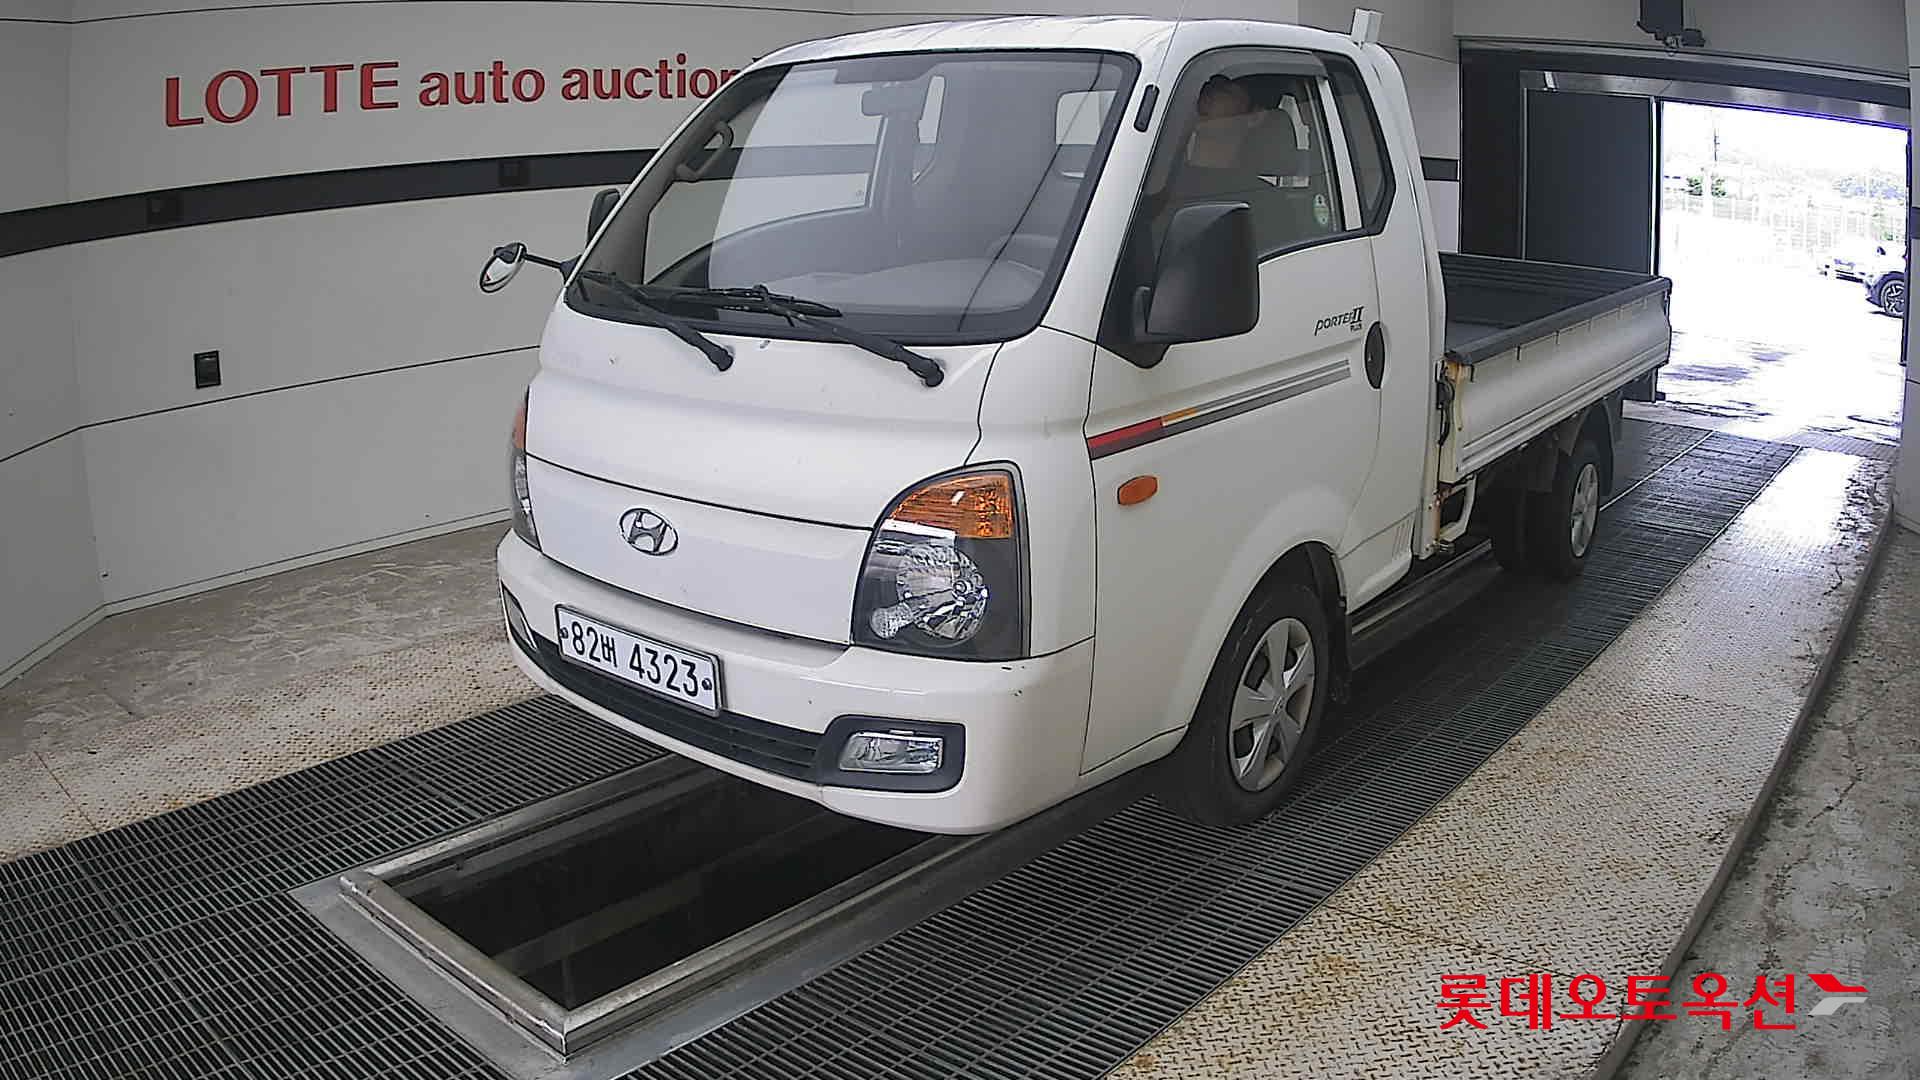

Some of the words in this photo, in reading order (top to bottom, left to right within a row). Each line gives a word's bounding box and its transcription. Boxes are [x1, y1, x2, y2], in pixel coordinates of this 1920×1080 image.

[165, 61, 399, 127] LOTTE
[418, 61, 545, 106] auto
[629, 643, 699, 697] 4323
